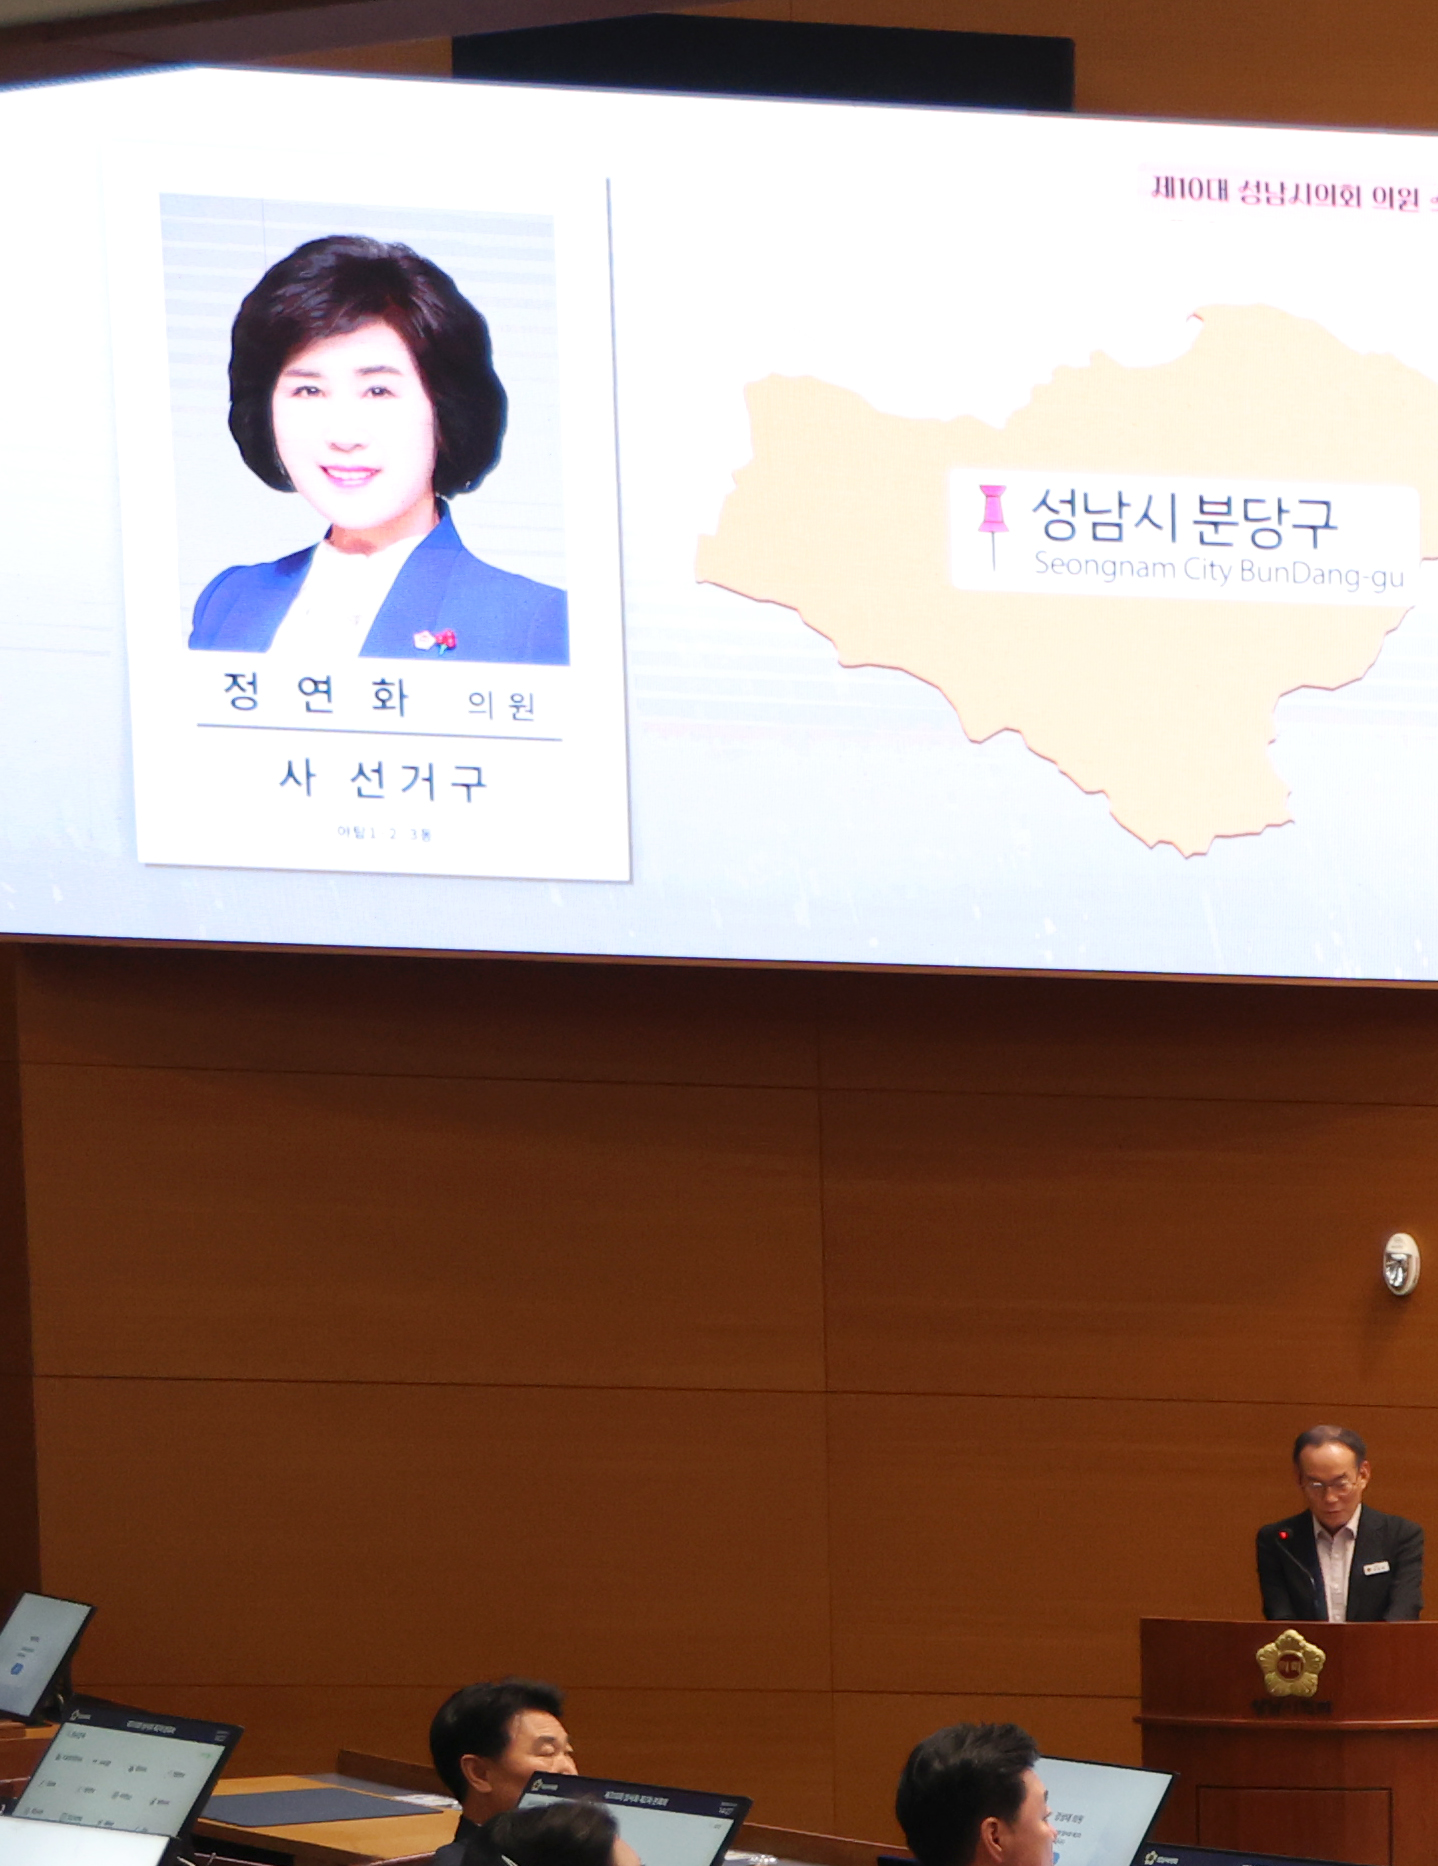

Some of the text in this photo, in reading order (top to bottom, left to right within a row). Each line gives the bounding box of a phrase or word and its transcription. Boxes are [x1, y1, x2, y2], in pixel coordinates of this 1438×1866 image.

[1152, 175, 1229, 202] 제10대
[1239, 180, 1361, 208] 성남시의회
[1372, 186, 1420, 213] 의원
[1033, 488, 1338, 549] 성남시 분당구
[1036, 551, 1404, 593] Seongnam City BunDang-gu
[469, 691, 534, 721] 의원
[280, 758, 487, 803] 사 선거구
